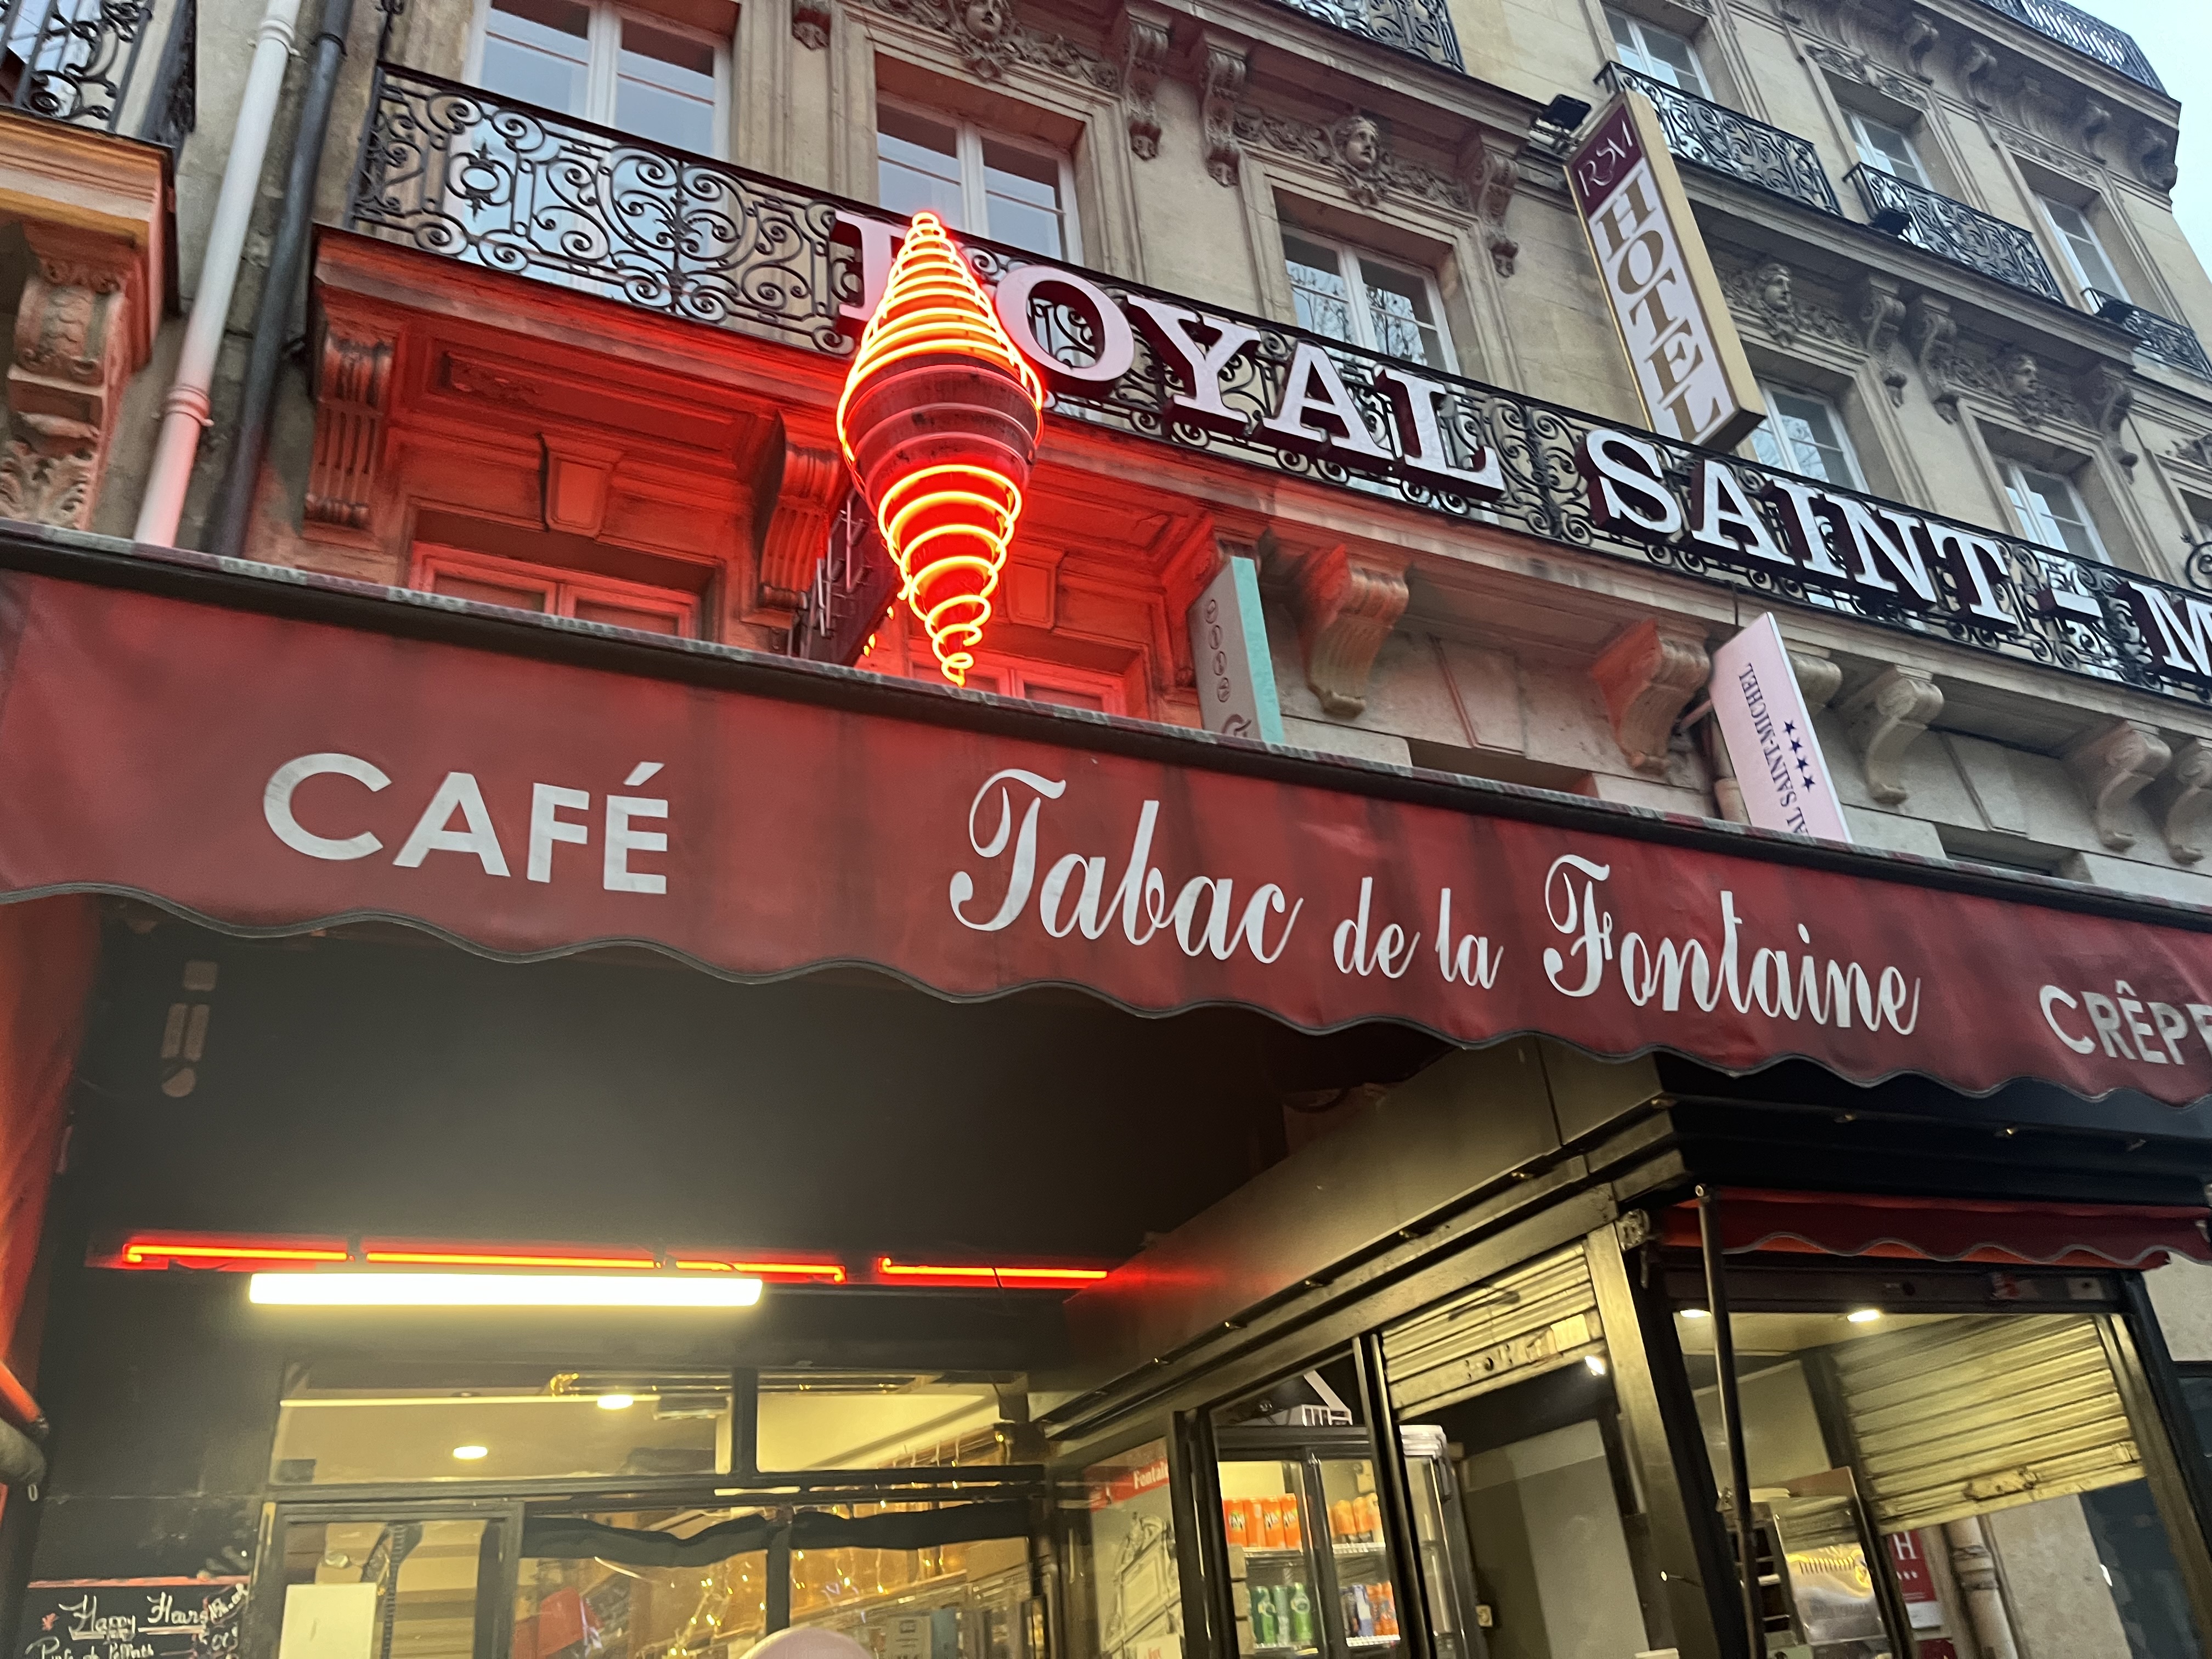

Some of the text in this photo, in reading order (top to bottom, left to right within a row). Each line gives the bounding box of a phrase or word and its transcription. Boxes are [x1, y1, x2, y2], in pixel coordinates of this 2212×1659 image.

[1594, 169, 1721, 441] HOTEL
[1739, 662, 1797, 807] SAINT-MICHEL
[263, 752, 669, 895] CAFÉ
[949, 768, 1920, 1035] Tabac de la Fontaine
[58, 1594, 136, 1645] Happy
